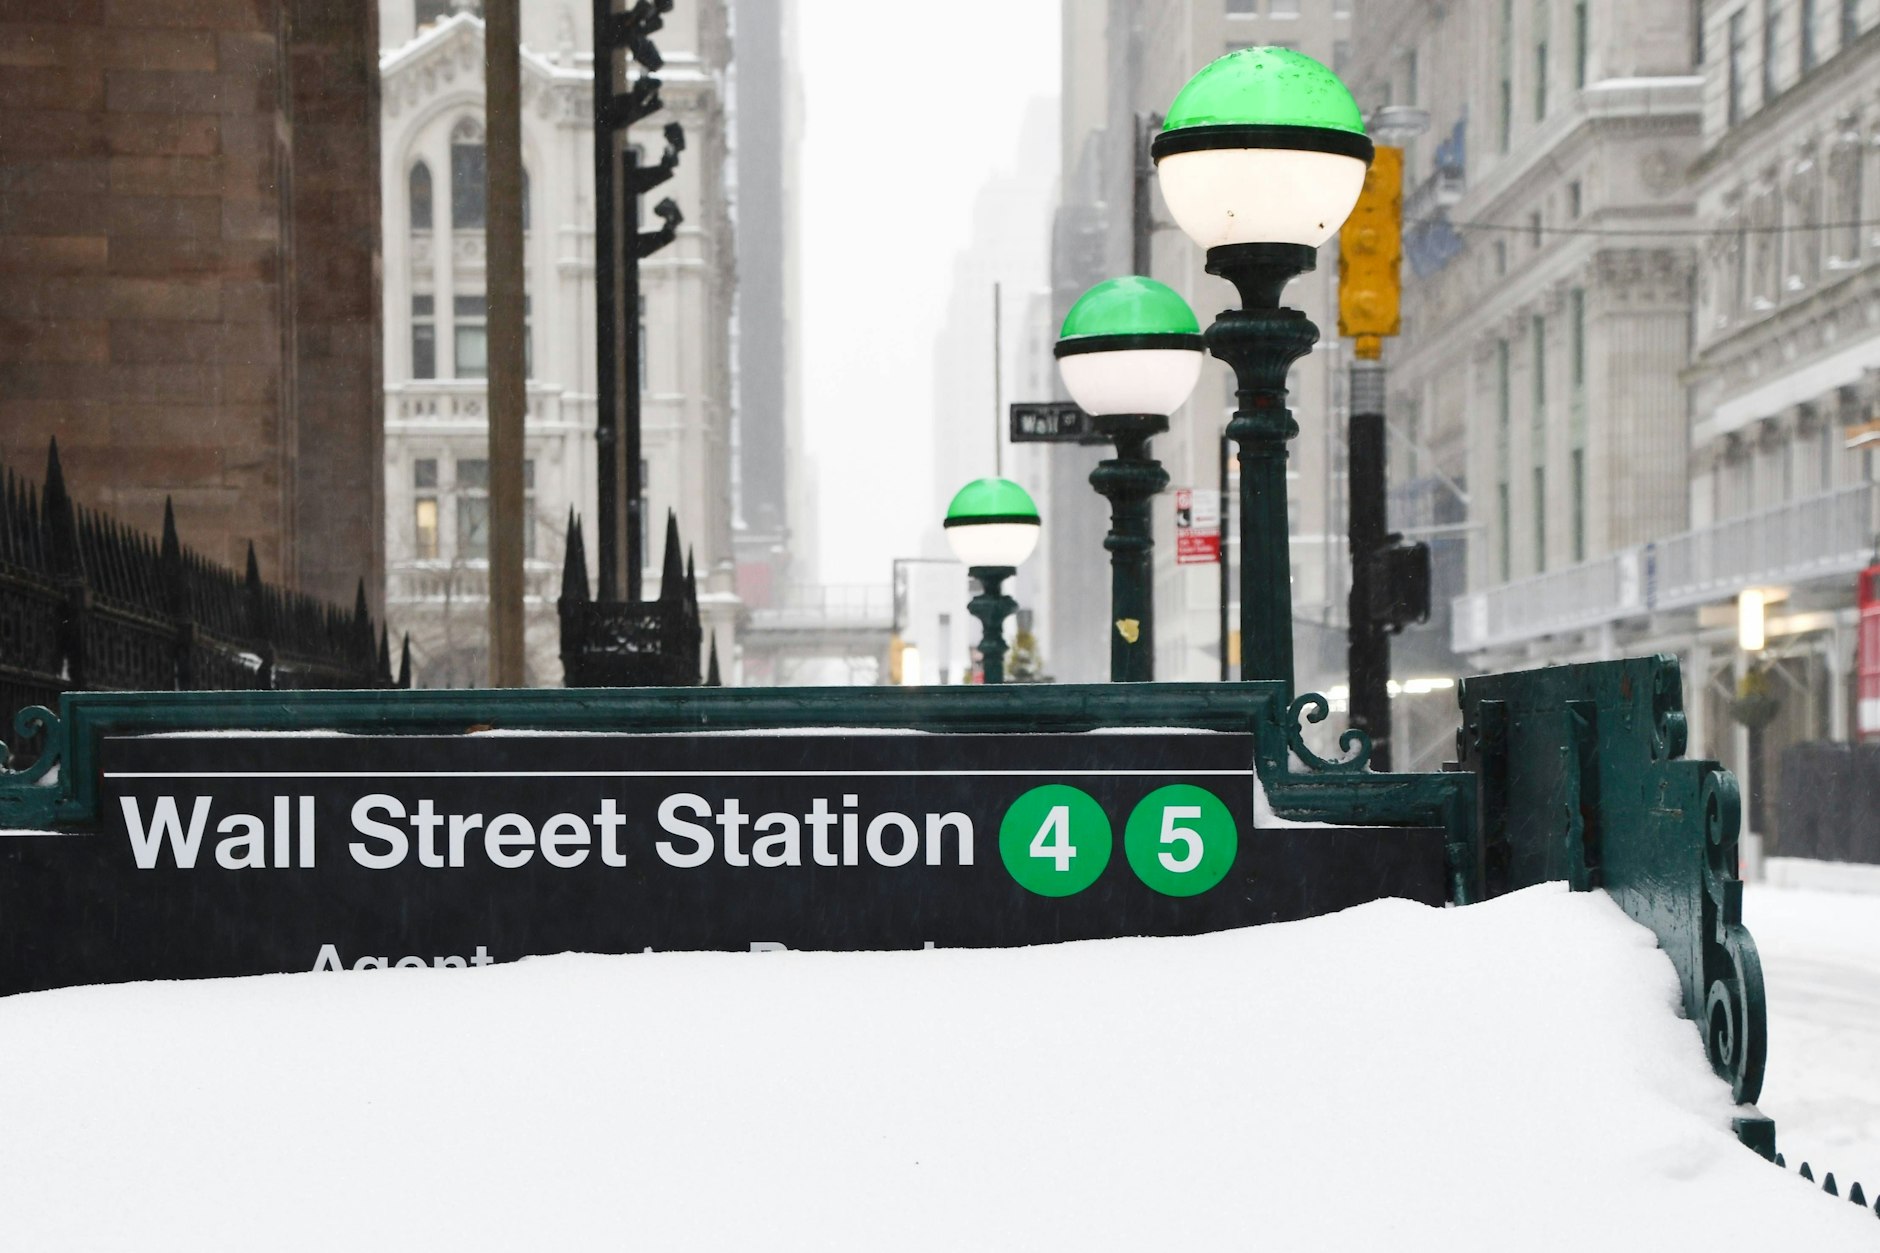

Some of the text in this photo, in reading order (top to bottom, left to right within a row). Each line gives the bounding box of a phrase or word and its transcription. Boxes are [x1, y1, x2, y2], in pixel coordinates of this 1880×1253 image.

[1021, 414, 1058, 434] Wall
[120, 793, 1204, 872] Wall Street Station 4 5
